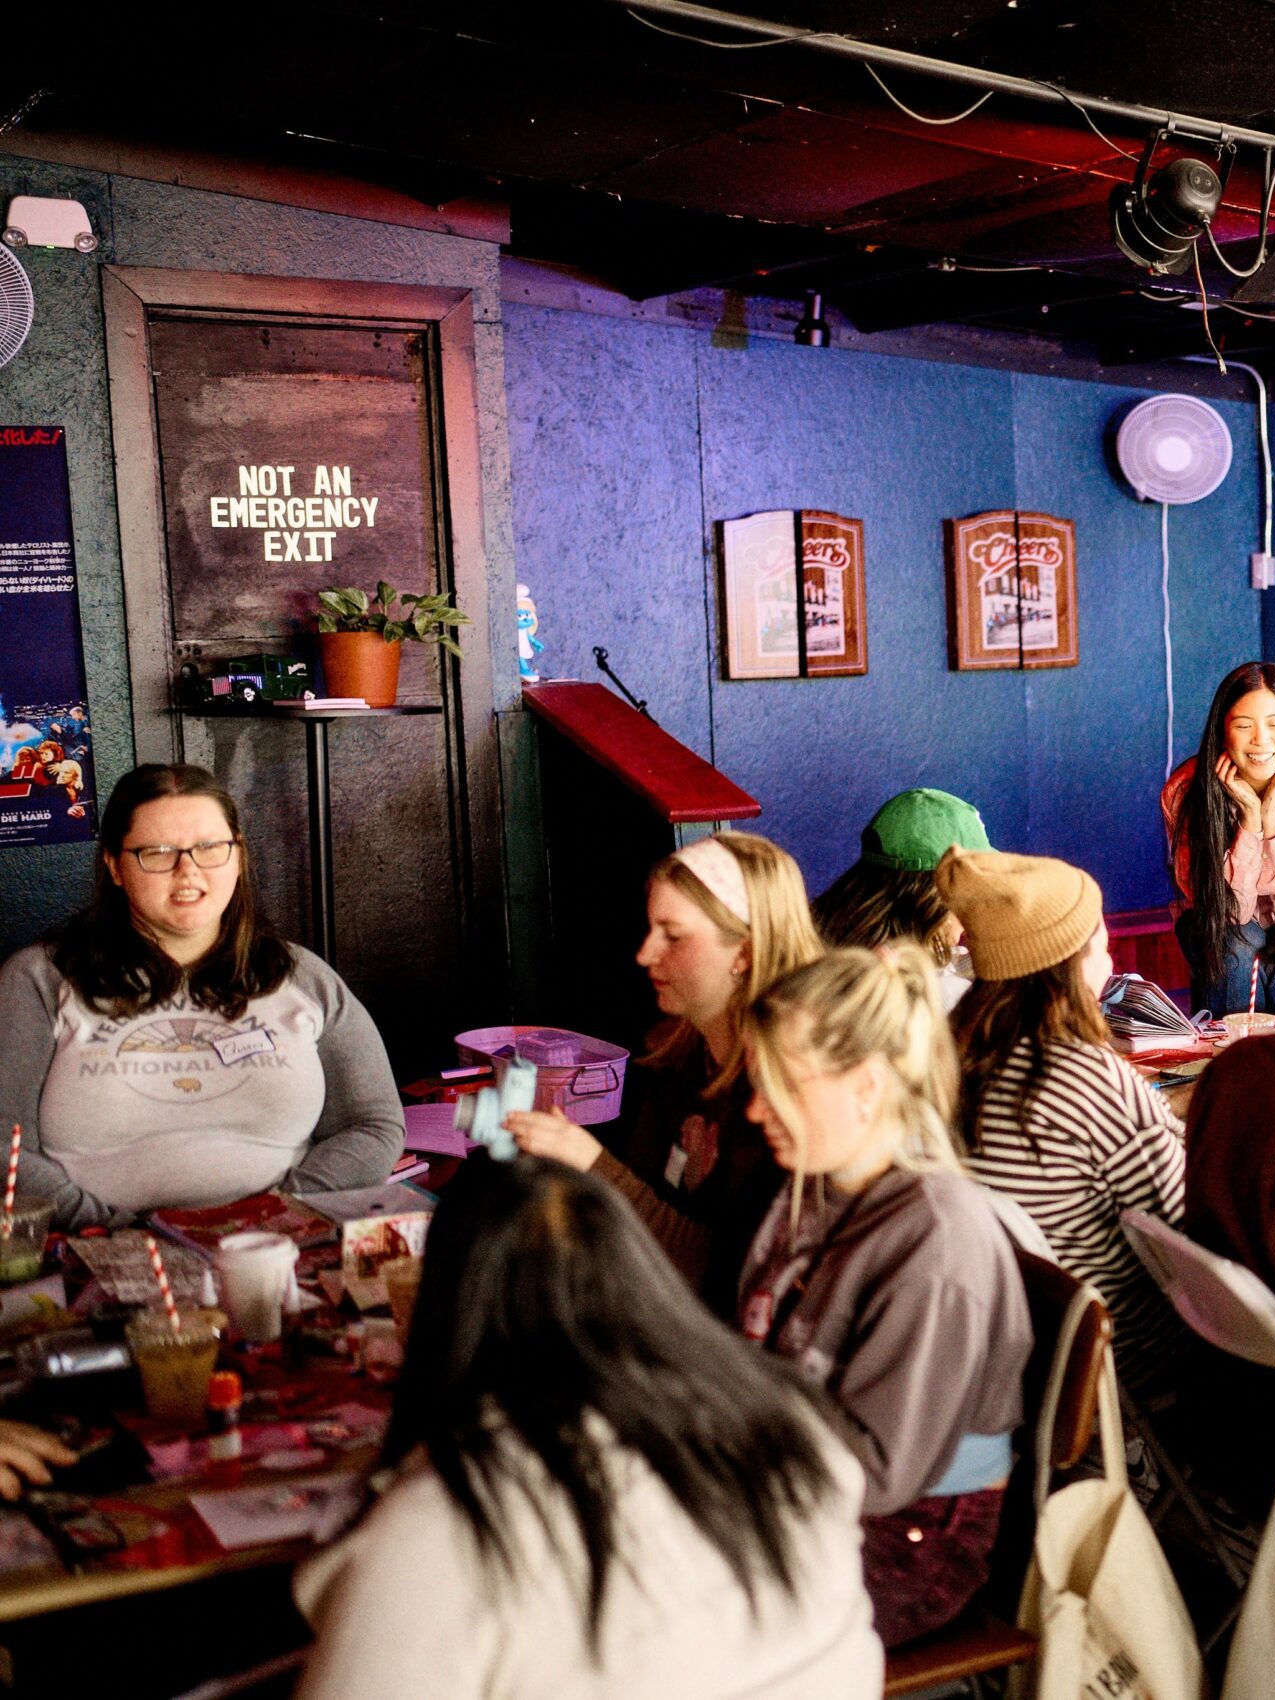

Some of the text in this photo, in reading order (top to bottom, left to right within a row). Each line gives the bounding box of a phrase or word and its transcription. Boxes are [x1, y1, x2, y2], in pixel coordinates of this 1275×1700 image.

[238, 465, 351, 496] NOT AN
[210, 497, 379, 528] EMERGENCY
[263, 531, 337, 562] EXIT
[969, 532, 1063, 582] Cheers
[1, 813, 52, 823] DIE HARD
[79, 1053, 293, 1078] NATIONAL ARK
